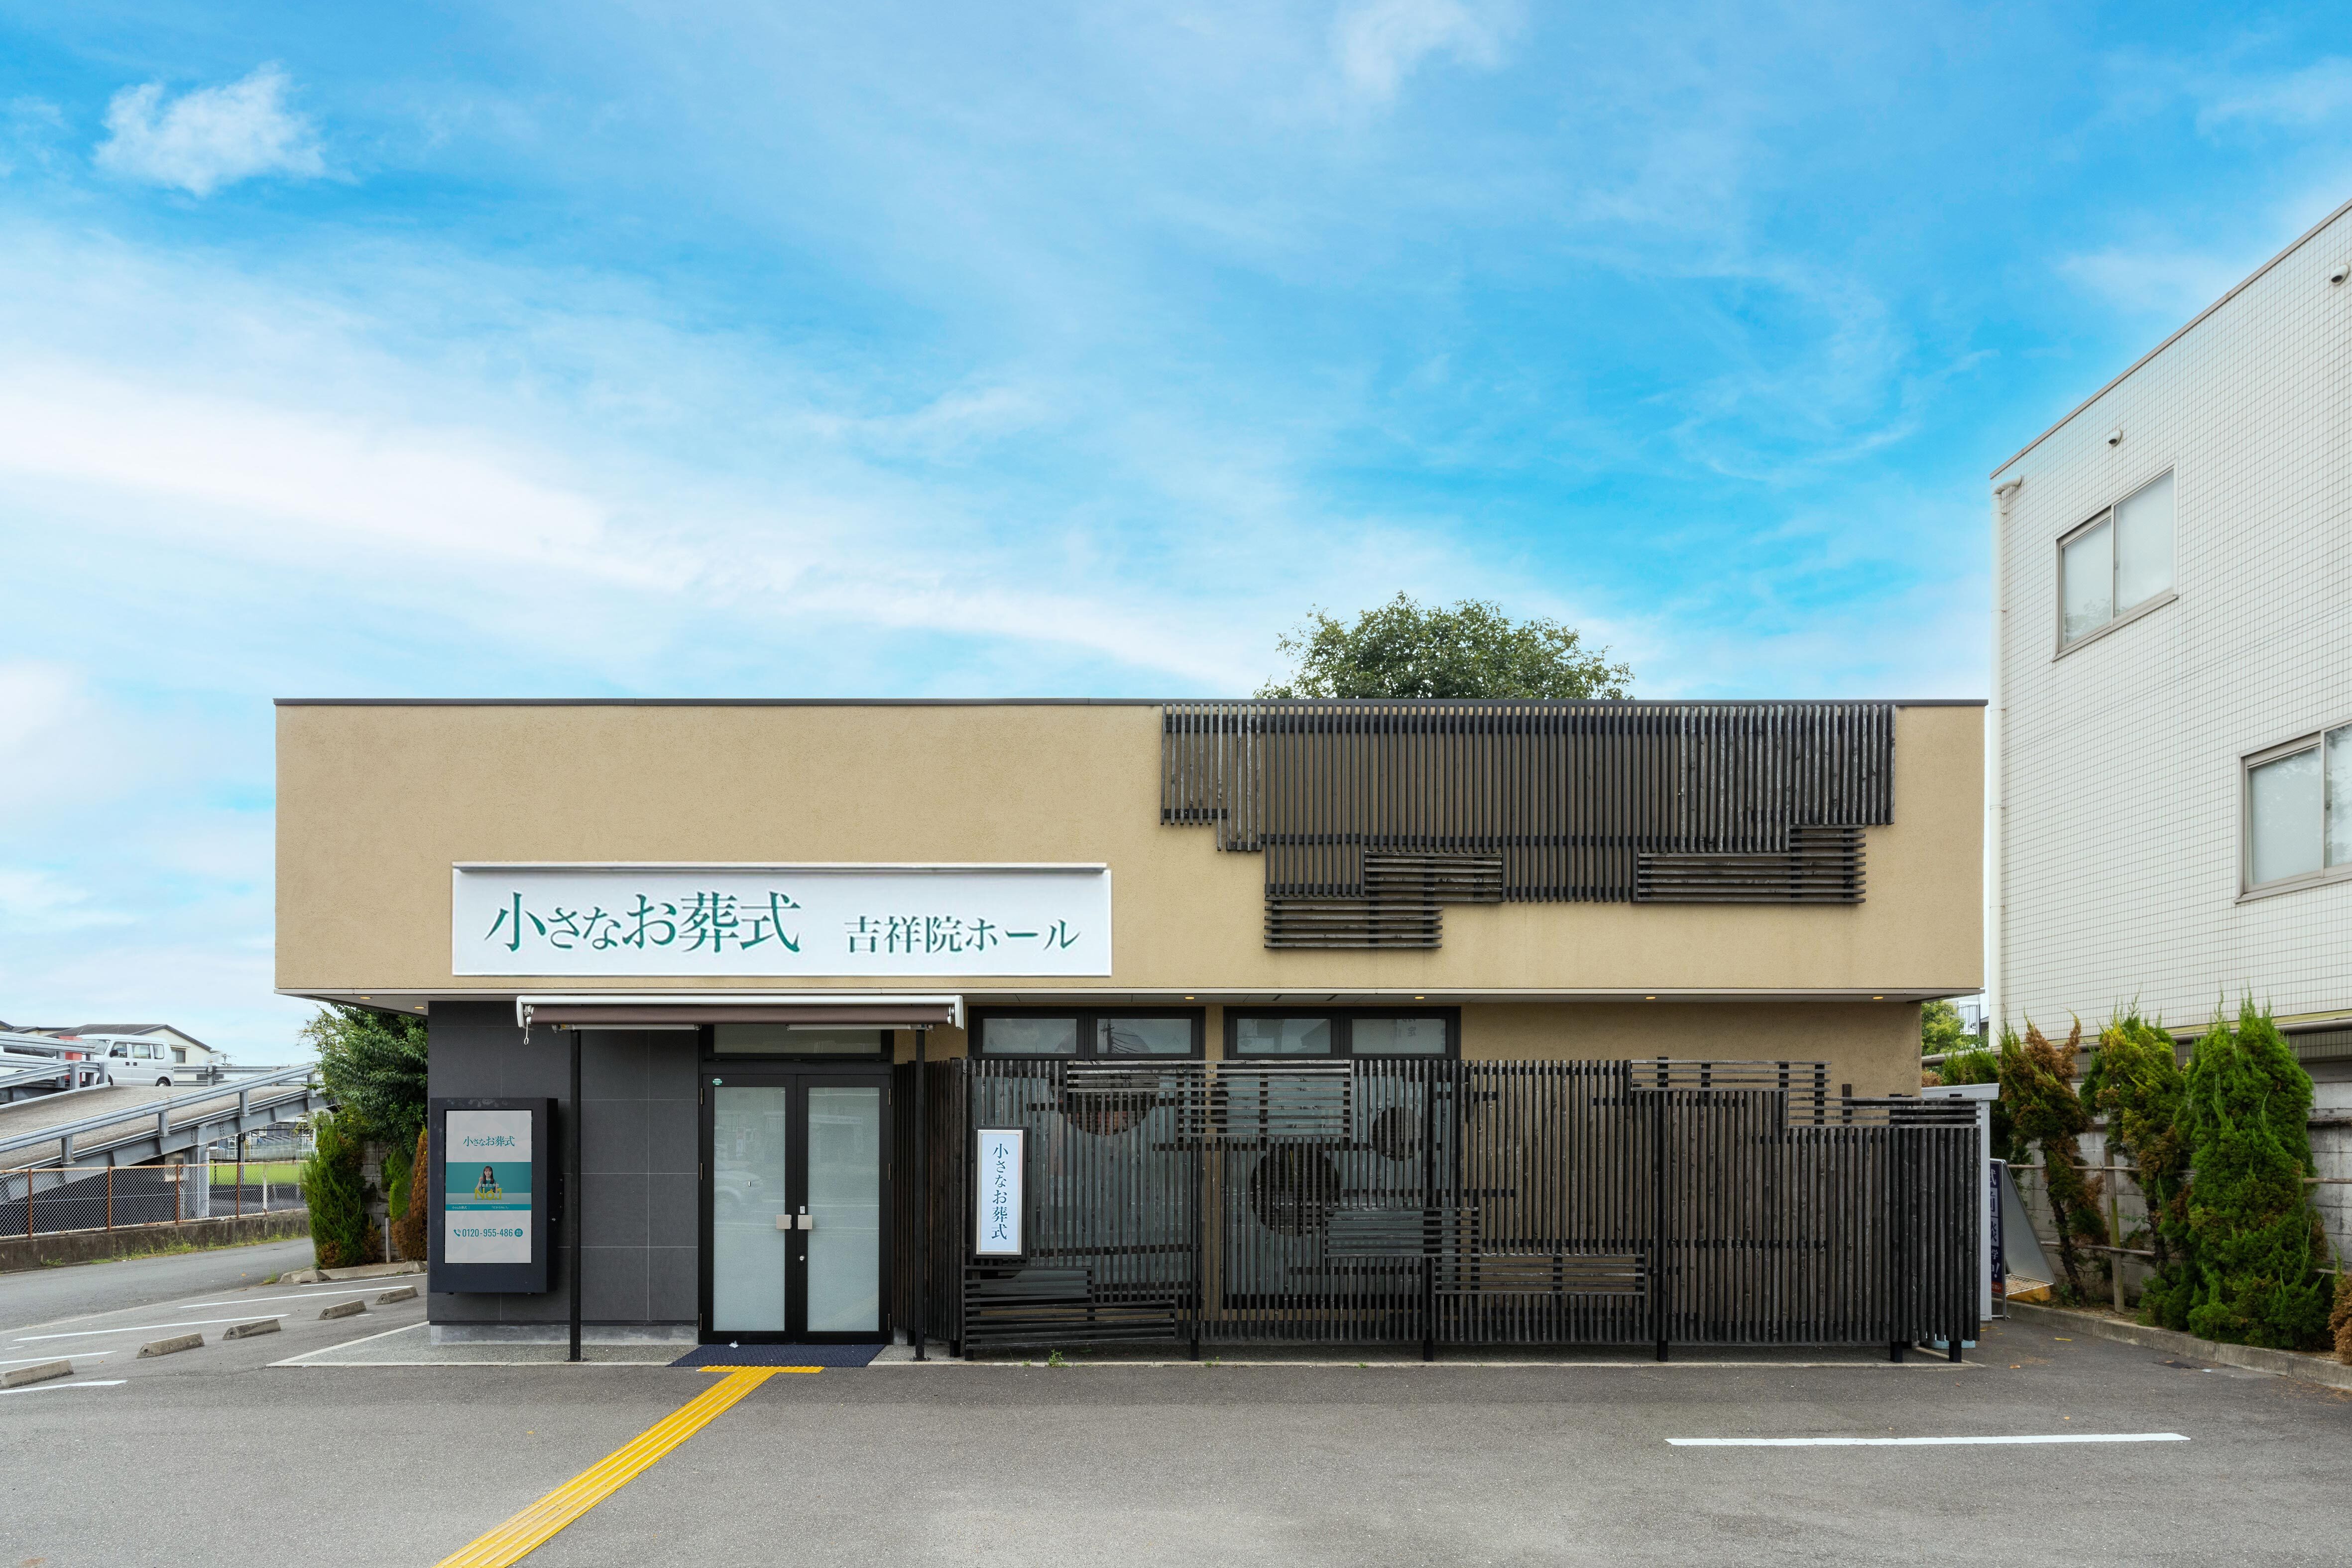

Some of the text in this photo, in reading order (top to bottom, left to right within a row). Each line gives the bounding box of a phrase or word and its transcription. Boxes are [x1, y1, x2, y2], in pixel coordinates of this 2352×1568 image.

[485, 891, 1081, 954] 小さなお葬式 吉祥院ホール
[463, 1136, 515, 1147] 小さなお葬式
[474, 1188, 502, 1201] No.1
[991, 1143, 1009, 1240] 小さなお葬式
[462, 1228, 513, 1237] 0120-955-486
